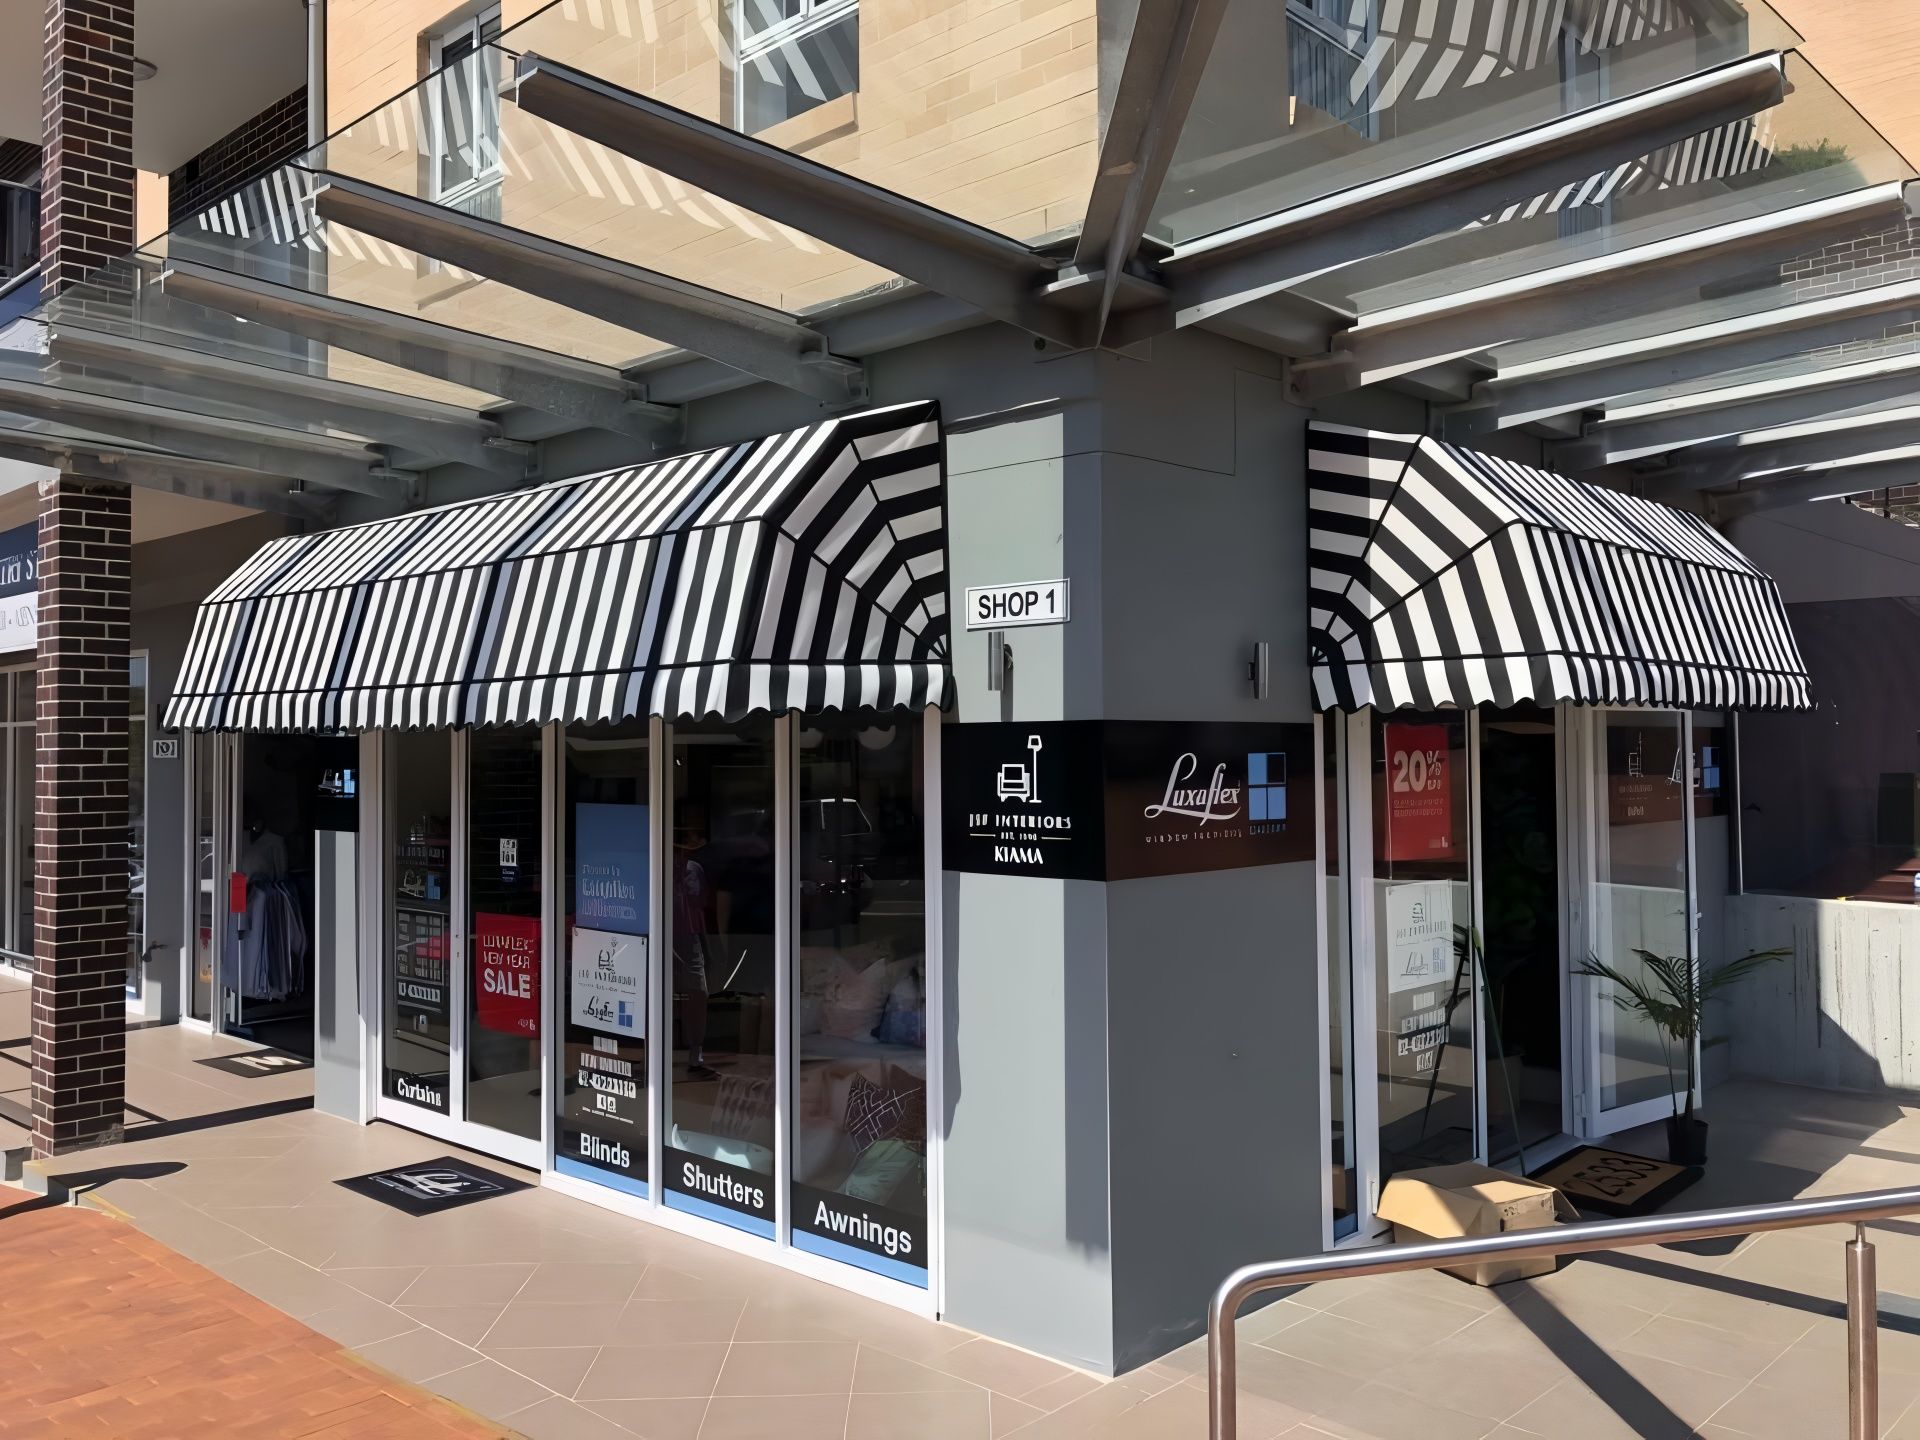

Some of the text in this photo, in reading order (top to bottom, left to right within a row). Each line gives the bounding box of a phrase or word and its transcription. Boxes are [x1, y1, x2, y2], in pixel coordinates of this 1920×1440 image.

[978, 588, 1056, 620] SHOP 1
[1143, 752, 1242, 827] Luxaflex
[994, 845, 1044, 865] KIAMA
[483, 967, 531, 999] SALE
[580, 1132, 631, 1168] Blinds
[682, 1161, 765, 1210] Shutters
[813, 1200, 913, 1256] Awnings
